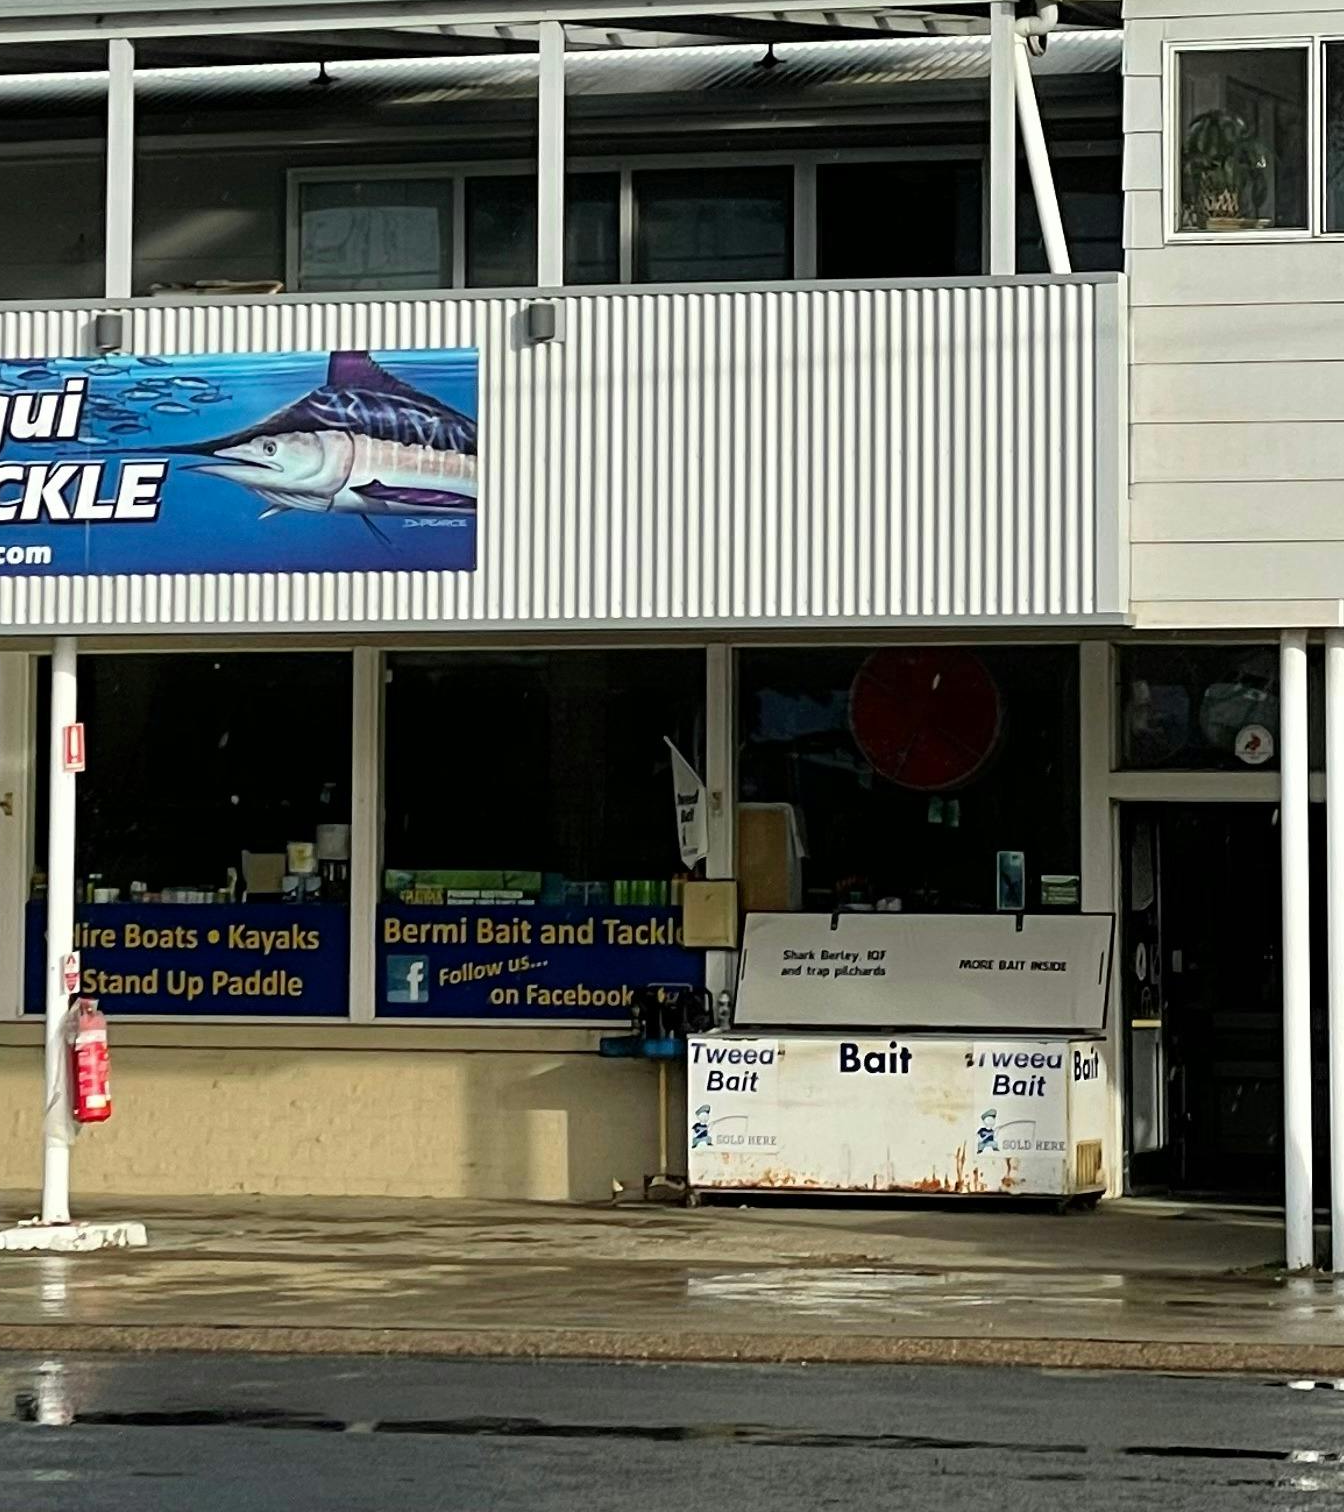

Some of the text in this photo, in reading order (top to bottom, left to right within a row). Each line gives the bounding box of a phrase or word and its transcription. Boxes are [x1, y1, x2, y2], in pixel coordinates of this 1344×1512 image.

[124, 923, 198, 949] Boats
[228, 923, 320, 955] Kayaks
[383, 917, 467, 944] Bermi
[476, 917, 532, 944] Bait
[540, 917, 594, 945] and
[783, 949, 815, 961] Shark
[958, 959, 1067, 972] MORE BAIT INSIDE
[438, 959, 503, 986] Follow
[781, 965, 802, 976] and
[806, 966, 830, 978] trap
[82, 968, 303, 1000] Stand Up Paddle
[490, 984, 634, 1007] on Facebook
[839, 1041, 913, 1074] Bait
[1073, 1046, 1099, 1081] Bait
[706, 1070, 759, 1092] Bait
[992, 1074, 1046, 1096] Bait
[716, 1135, 777, 1146] SOLD HERE
[1002, 1140, 1066, 1151] SOLD HERE
